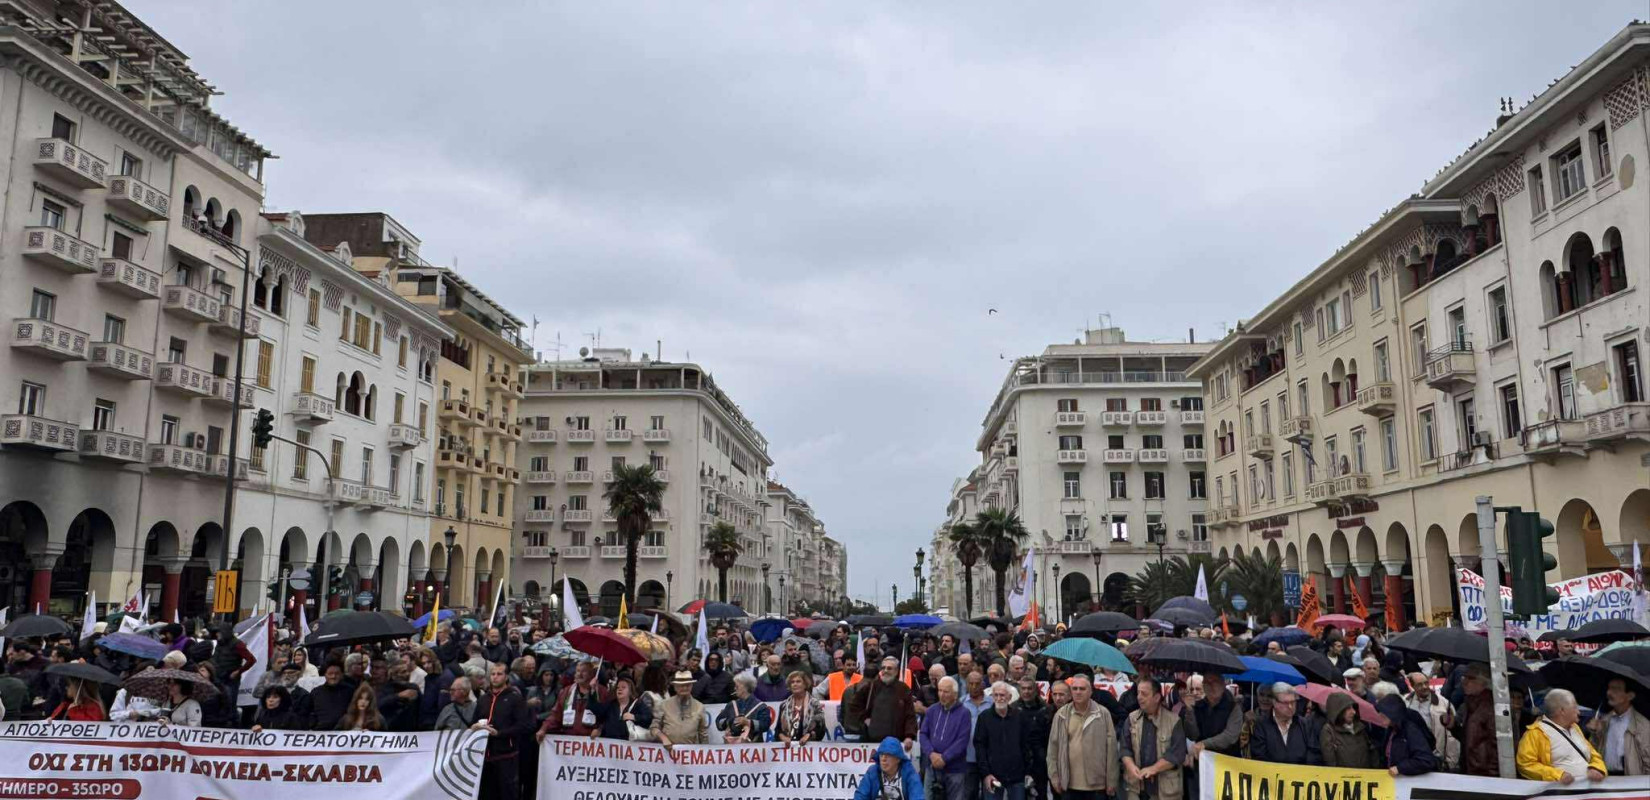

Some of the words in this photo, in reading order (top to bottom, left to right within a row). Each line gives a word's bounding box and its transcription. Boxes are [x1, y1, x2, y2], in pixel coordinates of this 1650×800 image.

[4, 723, 99, 738] ΑΠΟΣΥΡΘΕΙ
[109, 724, 130, 738] ΤΟ
[283, 733, 419, 749] ΤΕΡΑΤΟΥΡΓΗΜΑ
[28, 752, 67, 771] ΟΧΙ
[70, 753, 113, 771] ΣΤΗ
[119, 754, 186, 773] 13ΩΡΗ
[553, 740, 605, 758] ΤΕΡΜΑ
[609, 743, 634, 761] ΠΙΑ
[637, 746, 665, 764] ΣΤΑ
[669, 748, 735, 766] ΨΕΜΑΤΑ
[740, 748, 766, 764] ΚΑΙ
[771, 746, 813, 763] ΣΤΗΝ
[72, 782, 123, 796] 35ΩΡΟ
[556, 765, 629, 784] ΑΥΞΗΣΕΙΣ
[633, 770, 671, 789] ΤΩΡΑ
[675, 774, 694, 790] ΣΕ
[698, 771, 771, 790] ΜΙΣΘΟΥΣ
[775, 772, 801, 789] ΚΑΙ
[806, 773, 866, 789] ΣΥΝΤΑ
